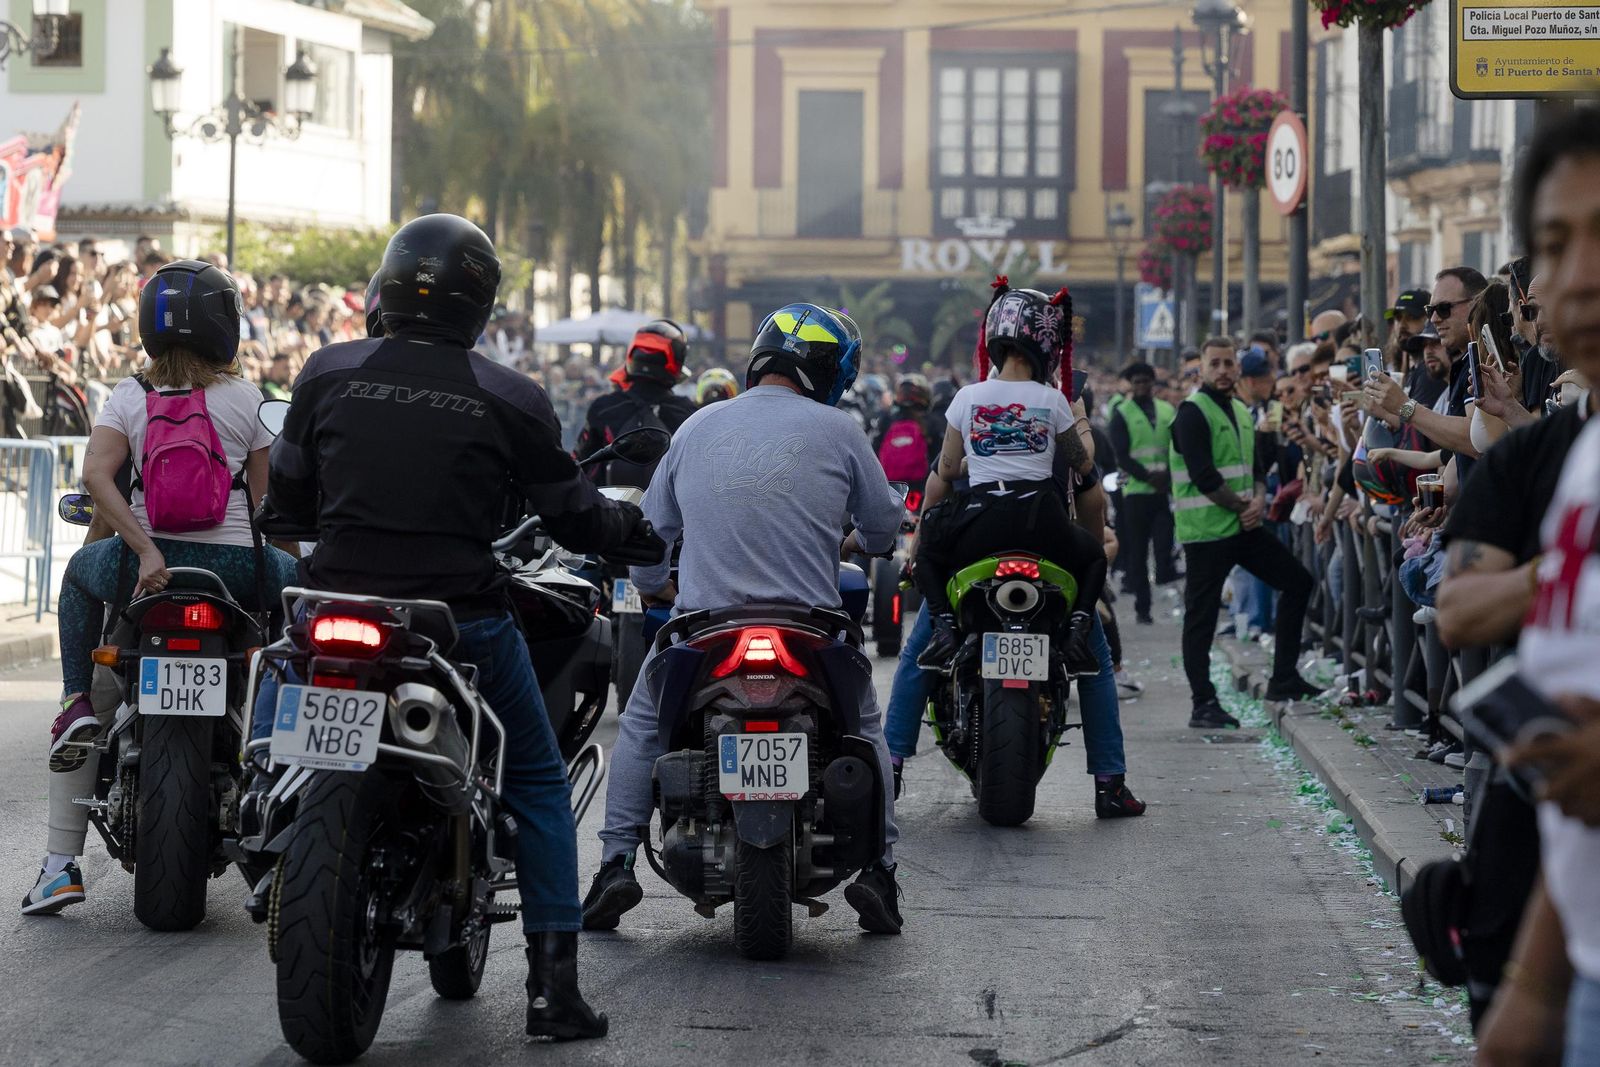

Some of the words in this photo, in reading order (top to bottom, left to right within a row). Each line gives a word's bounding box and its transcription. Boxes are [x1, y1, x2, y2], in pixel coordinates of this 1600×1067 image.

[1503, 10, 1529, 21] Local
[1531, 10, 1562, 20] Puerto
[1564, 10, 1576, 20] de
[1470, 25, 1489, 35] Gta.
[1492, 25, 1522, 37] Miguel
[1525, 25, 1547, 35] Pozo
[1549, 24, 1582, 36] Muñoz,
[1584, 24, 1598, 34] s/n
[1495, 57, 1561, 67] Ayuntamiento
[1563, 57, 1574, 65] de
[1494, 68, 1504, 77] El
[1508, 68, 1543, 77] Puerto
[1545, 67, 1559, 77] de
[1561, 67, 1593, 77] Santa
[999, 637, 1043, 657] 6851
[164, 663, 221, 686] 1183
[998, 657, 1033, 676] DVC
[146, 681, 153, 689] E
[161, 688, 206, 711] DHK
[303, 692, 378, 727] 5602
[282, 713, 293, 724] E
[305, 724, 363, 756] NBG
[741, 737, 802, 762] 7057
[726, 760, 733, 769] E
[741, 764, 787, 788] MNB
[749, 792, 799, 800] ROMERO
